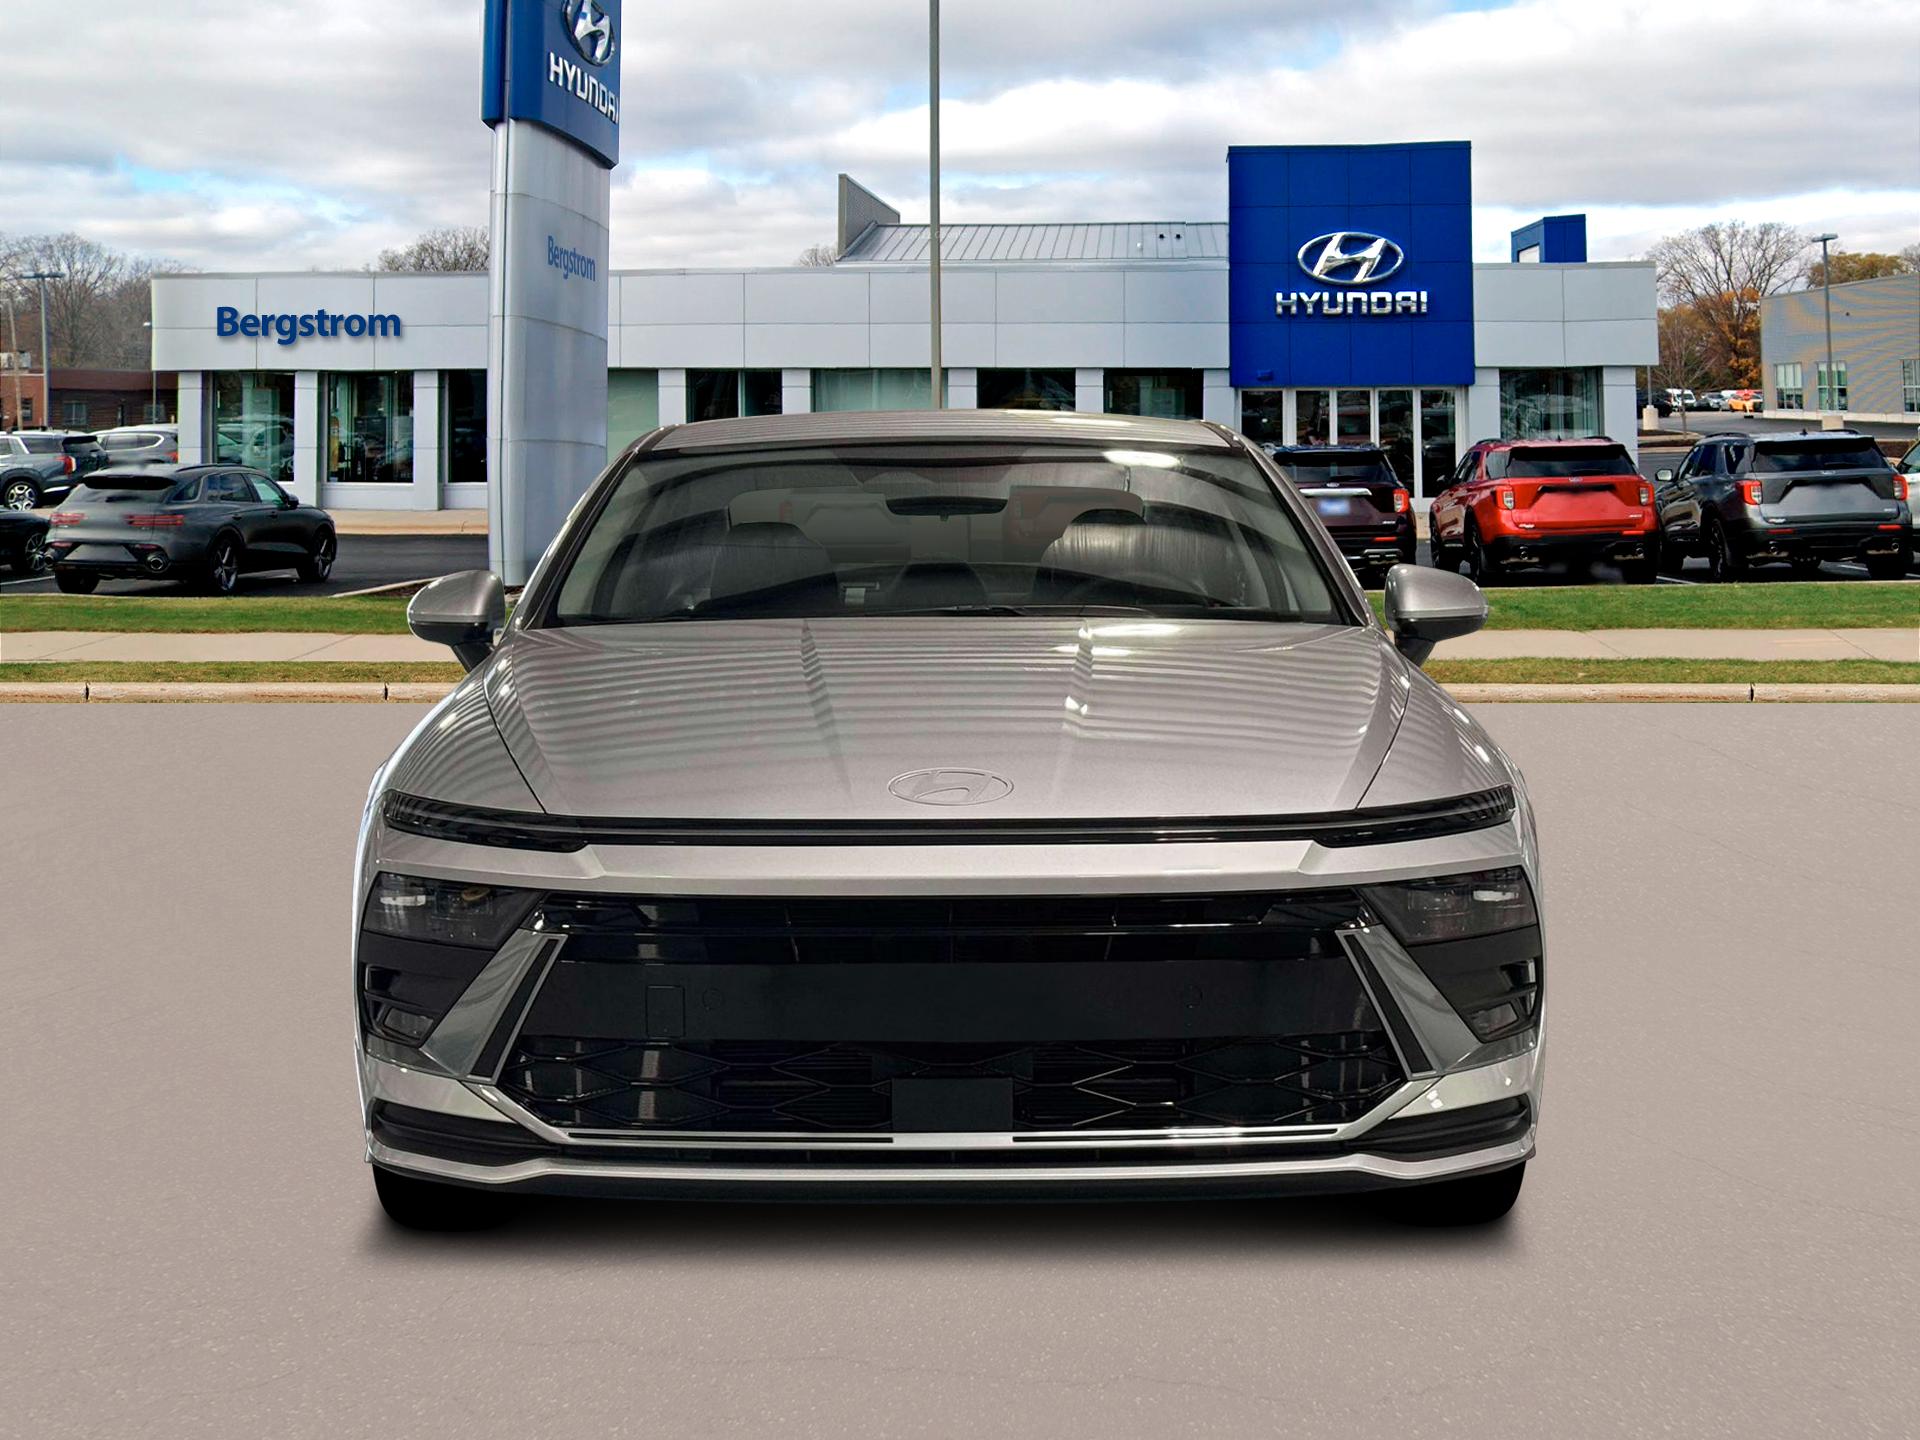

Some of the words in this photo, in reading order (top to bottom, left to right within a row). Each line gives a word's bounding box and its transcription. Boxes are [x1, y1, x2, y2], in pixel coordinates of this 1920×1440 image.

[549, 52, 619, 124] HYUNDAI
[547, 235, 596, 281] Bergstrom
[1275, 290, 1428, 315] HYUNDAI
[216, 306, 401, 346] Bergstrom
